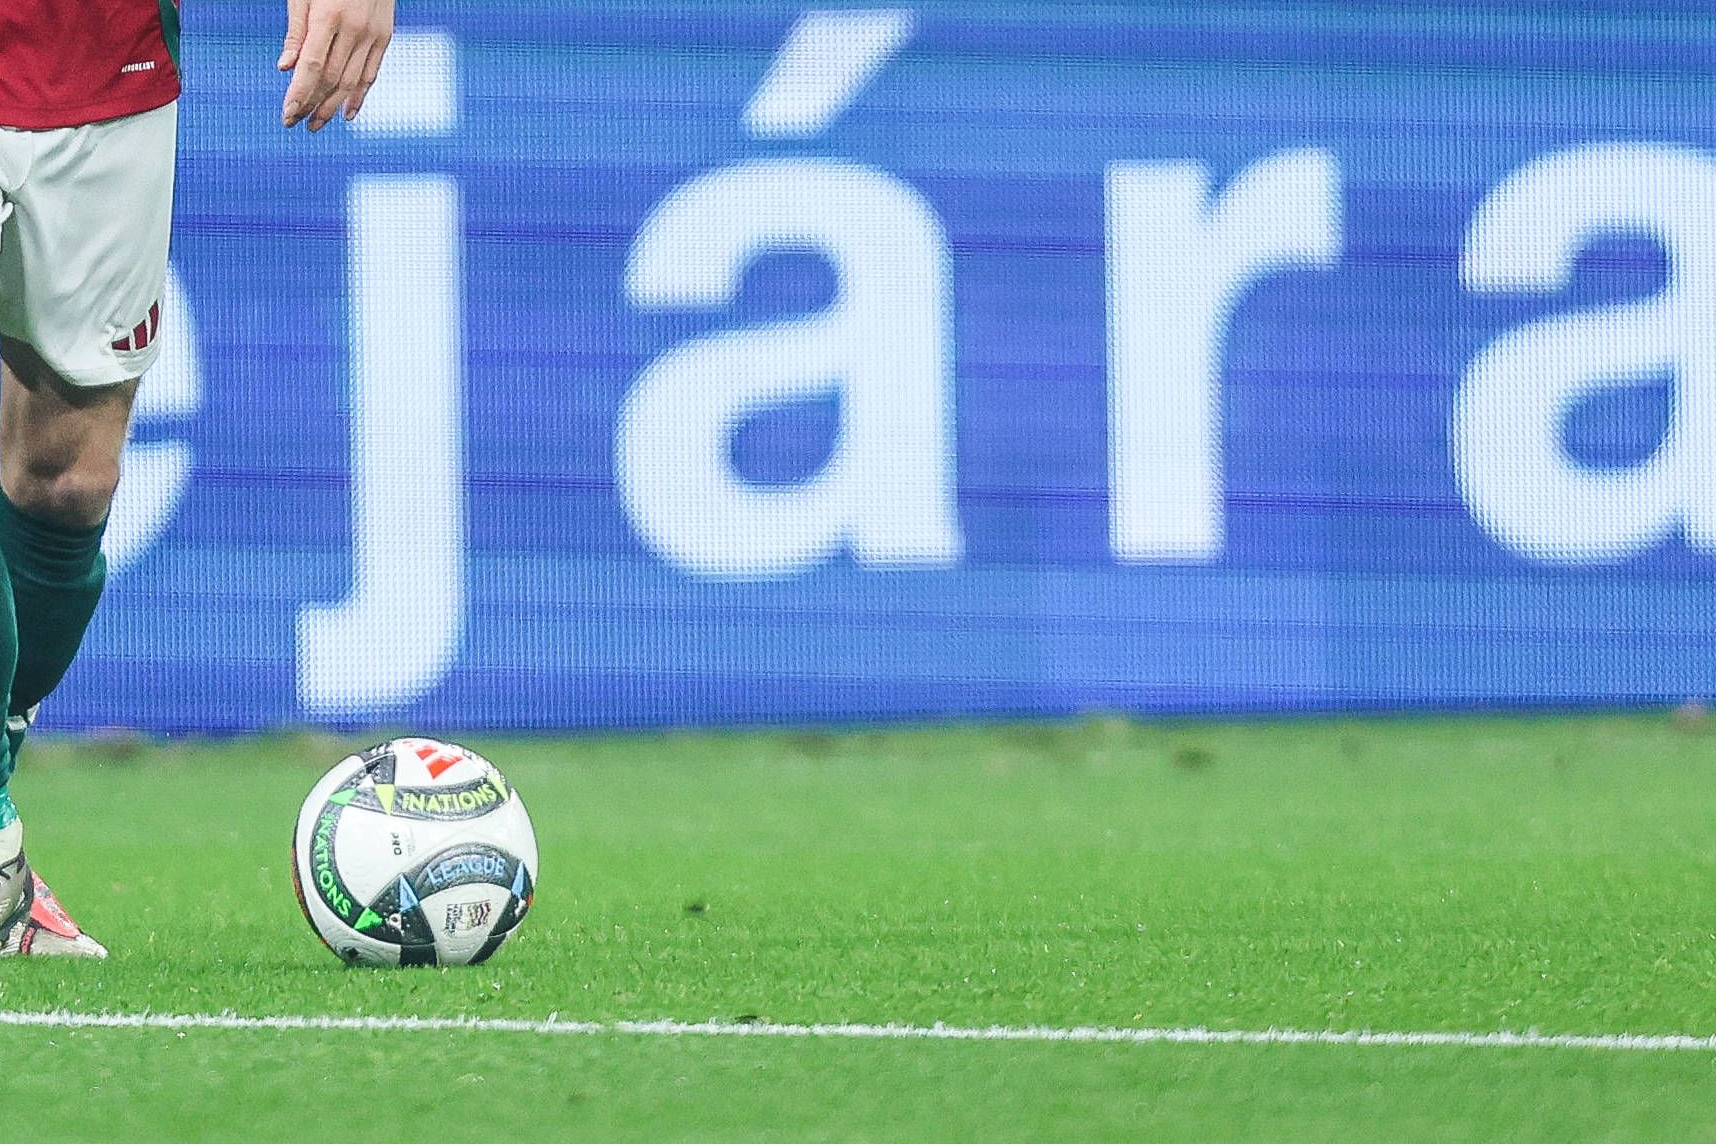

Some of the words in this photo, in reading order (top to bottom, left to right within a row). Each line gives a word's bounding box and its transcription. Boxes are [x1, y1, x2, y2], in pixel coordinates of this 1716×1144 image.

[408, 784, 497, 812] NATIONS
[315, 818, 352, 918] NATIONS
[426, 856, 509, 885] LEAGUE
